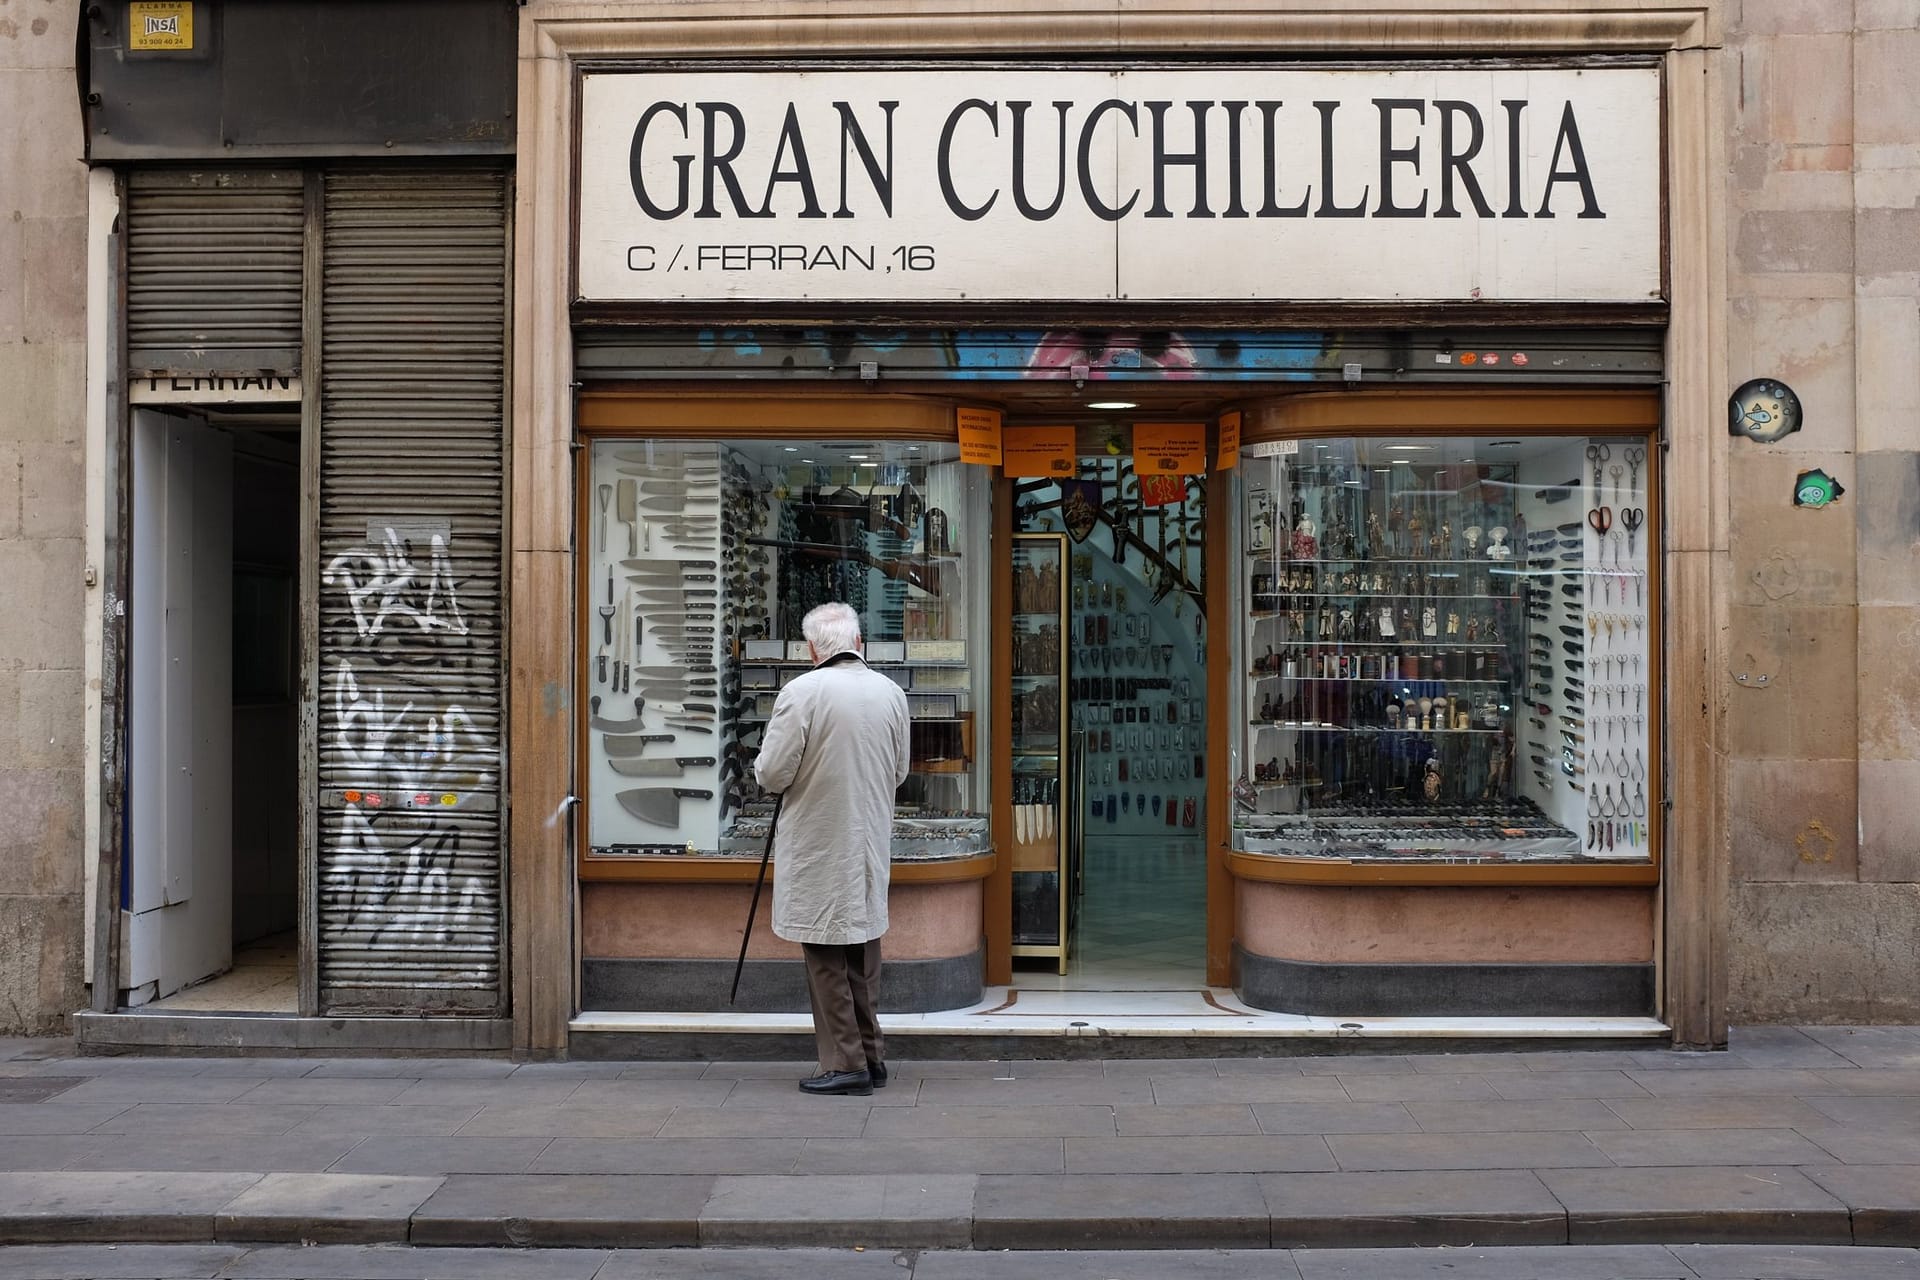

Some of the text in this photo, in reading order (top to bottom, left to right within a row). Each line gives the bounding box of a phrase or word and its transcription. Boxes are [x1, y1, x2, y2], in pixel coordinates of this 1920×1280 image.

[147, 17, 177, 33] INSA
[629, 98, 1607, 222] GRAN CUCHILLERIA
[697, 245, 875, 271] FERRAN
